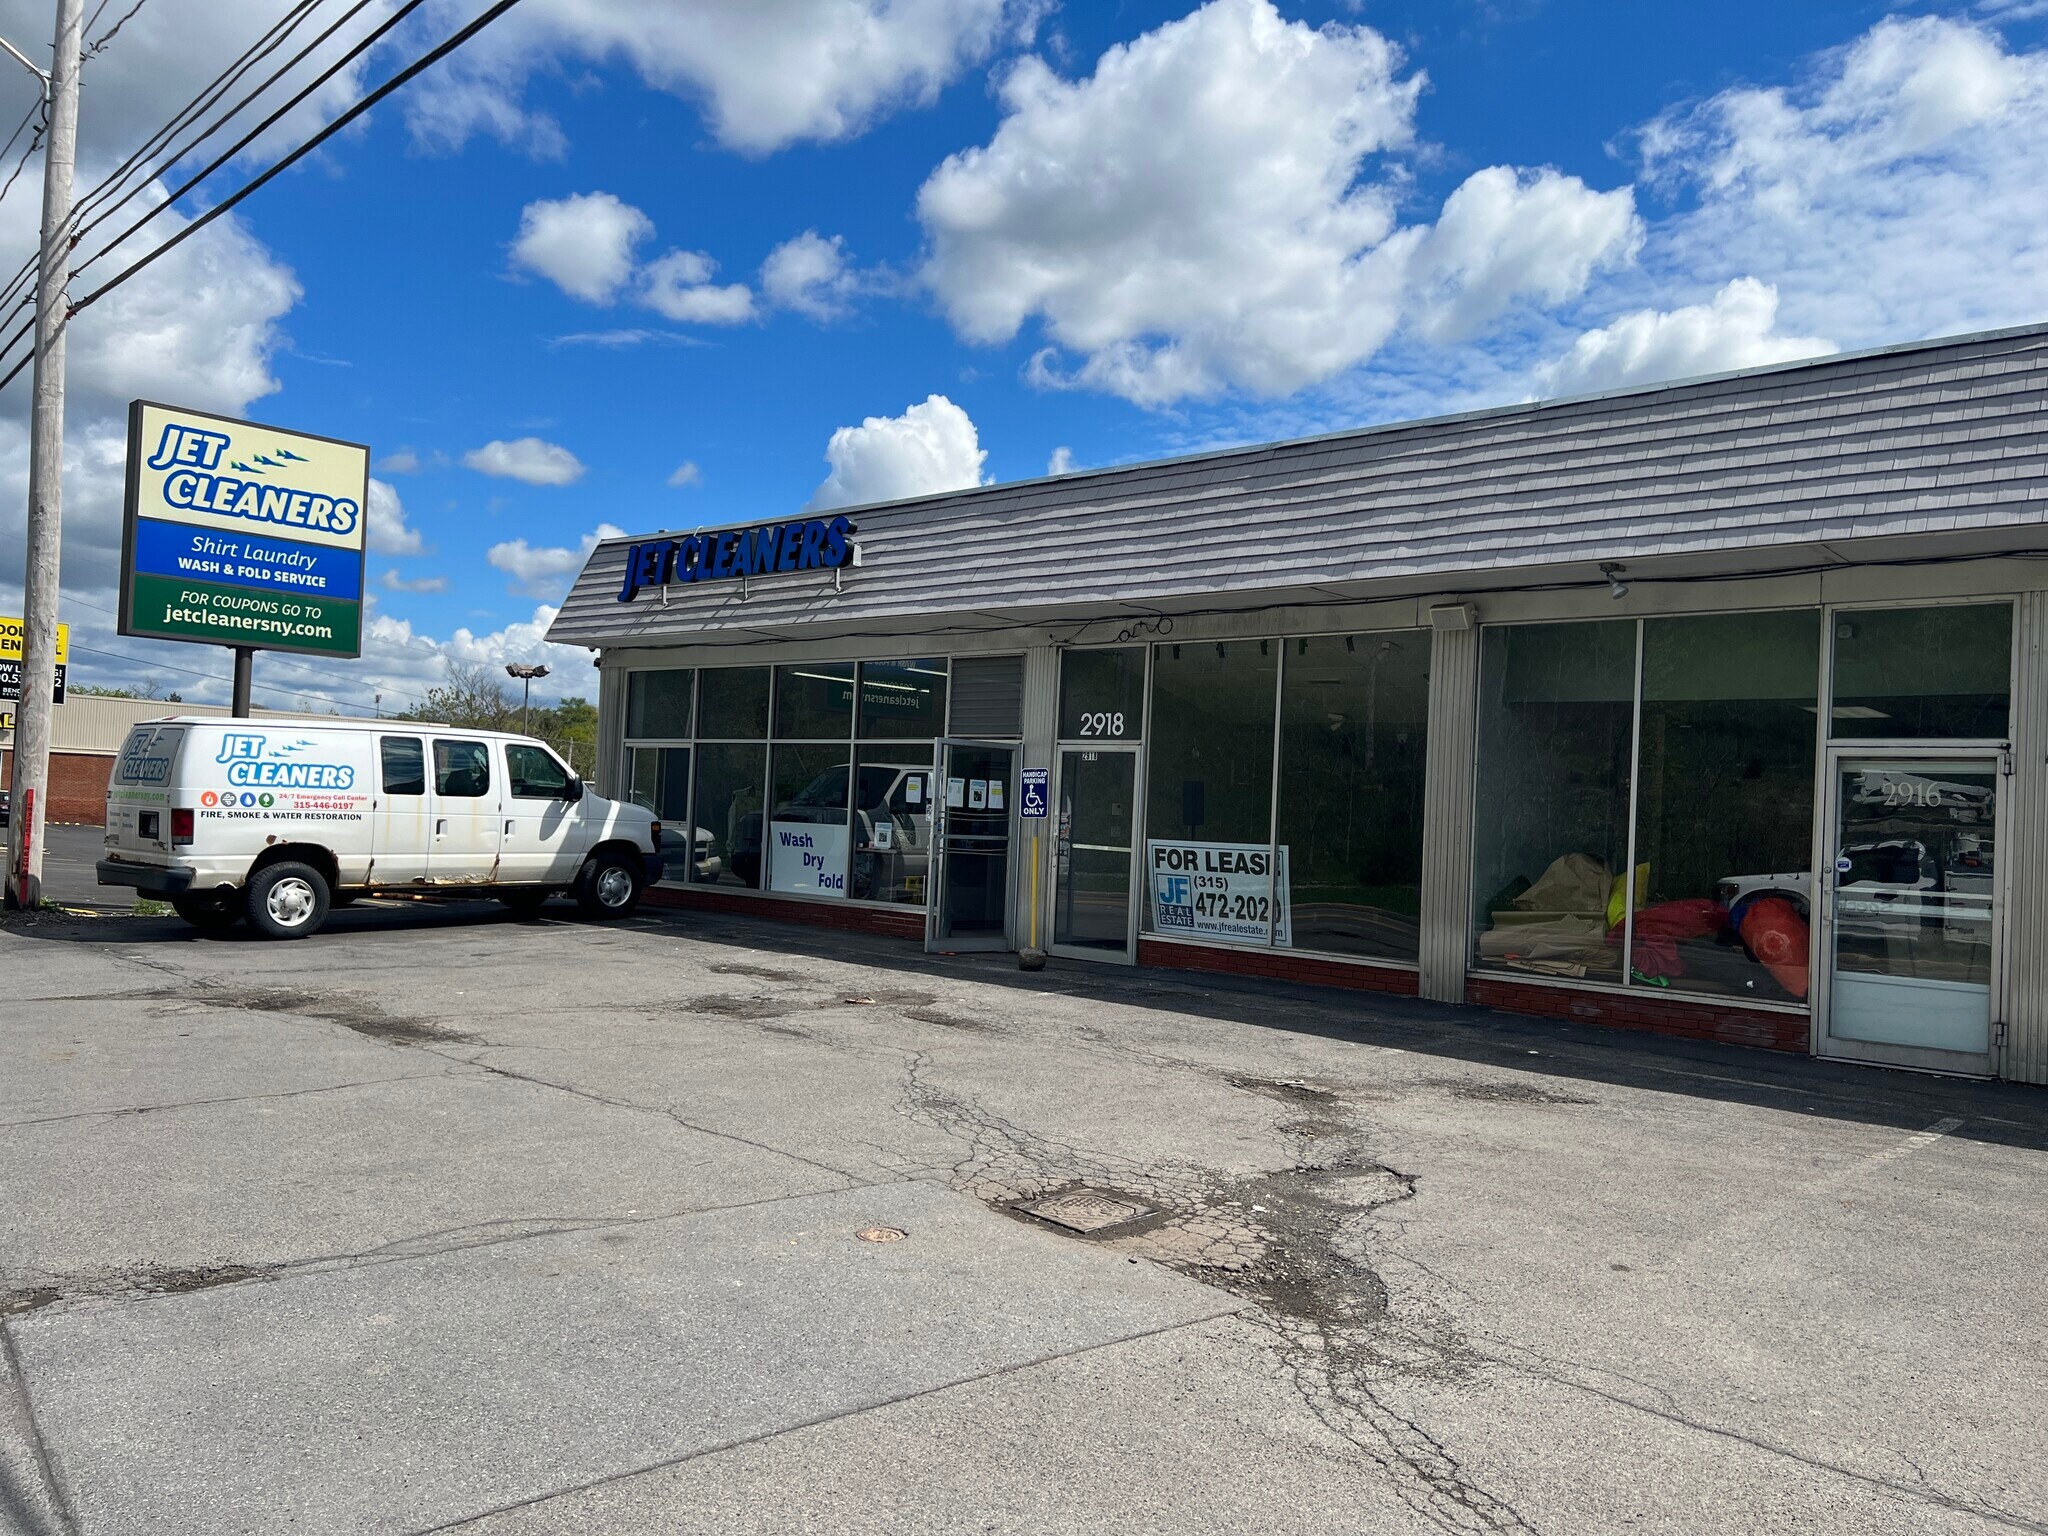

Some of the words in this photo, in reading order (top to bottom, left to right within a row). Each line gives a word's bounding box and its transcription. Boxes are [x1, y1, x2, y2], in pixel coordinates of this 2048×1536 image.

[149, 425, 229, 469] JET
[164, 471, 357, 533] CLEANERS
[191, 536, 238, 558] Shirt
[244, 543, 317, 570] Laundry
[618, 541, 676, 602] JET
[676, 515, 855, 583] CLEANERS
[178, 557, 219, 574] WASH
[223, 563, 234, 575] &
[238, 565, 271, 580] FOLD
[274, 570, 326, 587] SERVICE
[180, 590, 209, 606] FOR
[213, 595, 278, 614] COUPONS
[281, 604, 300, 617] GO
[304, 606, 322, 619] TO
[163, 604, 333, 638] jetcleanersny.com
[1080, 712, 1125, 736] 2918
[217, 734, 266, 763] JET
[228, 761, 355, 790] CLEANERS
[293, 801, 354, 810] 315-446-0197
[1882, 782, 1942, 807] 2916
[200, 811, 225, 819] FIRE,
[227, 811, 261, 819] SMOKE
[304, 812, 362, 821] RESTORATION
[779, 832, 814, 848] Wash
[803, 852, 825, 870] Dry
[1154, 848, 1199, 871] FOR
[818, 873, 844, 890] Fold
[1160, 877, 1188, 904] JF
[1194, 875, 1229, 891] (315)
[1160, 905, 1192, 916] REAL
[1161, 915, 1193, 926] ESTATE
[1197, 921, 1283, 938] www.jfrealestate.m
